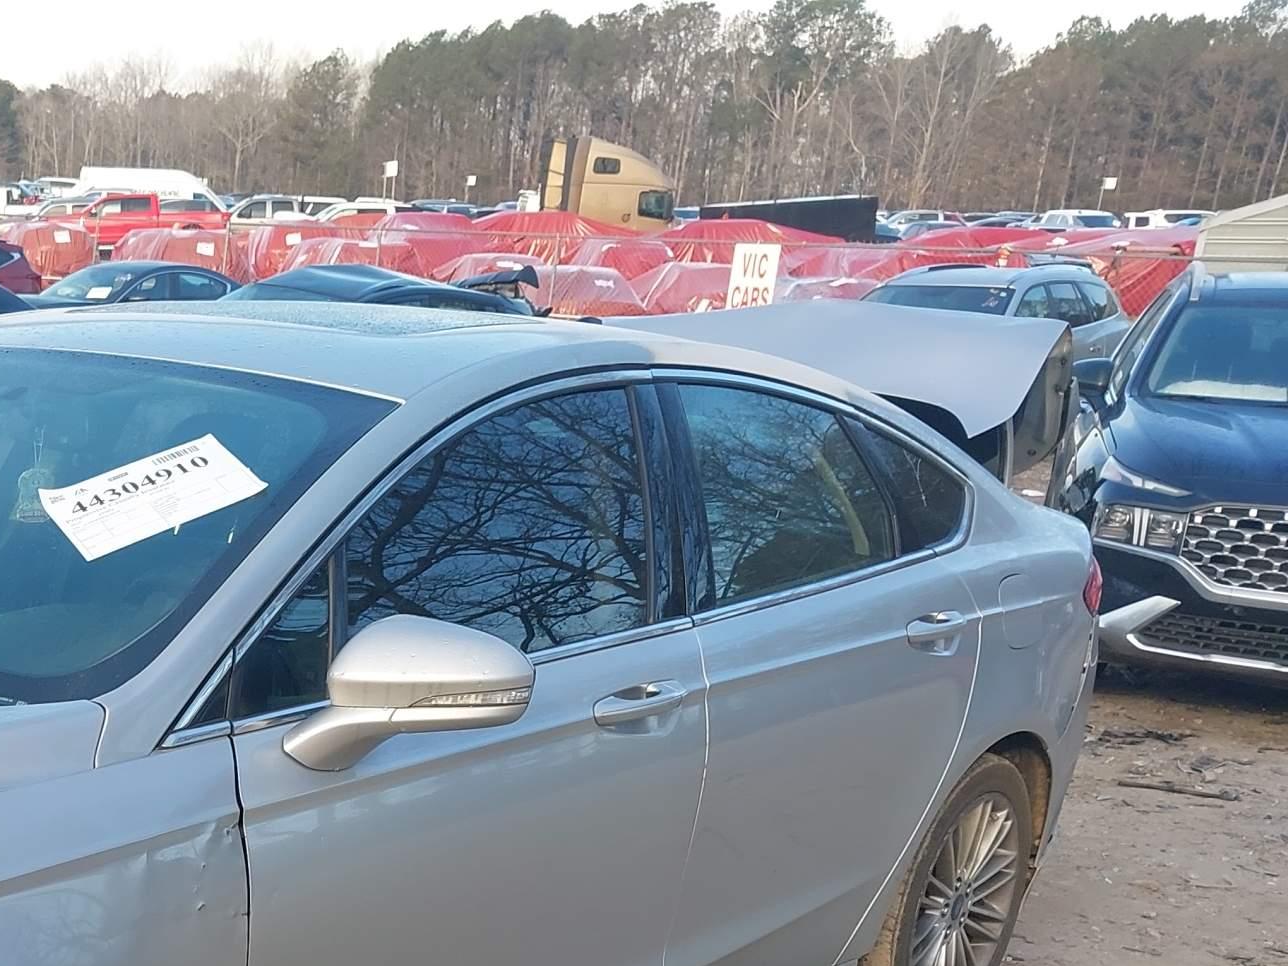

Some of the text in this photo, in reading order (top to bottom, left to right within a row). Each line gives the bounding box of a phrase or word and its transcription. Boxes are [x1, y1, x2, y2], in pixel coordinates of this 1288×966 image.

[743, 252, 769, 278] VIC
[731, 286, 770, 309] CARS
[71, 455, 209, 514] 44304910
